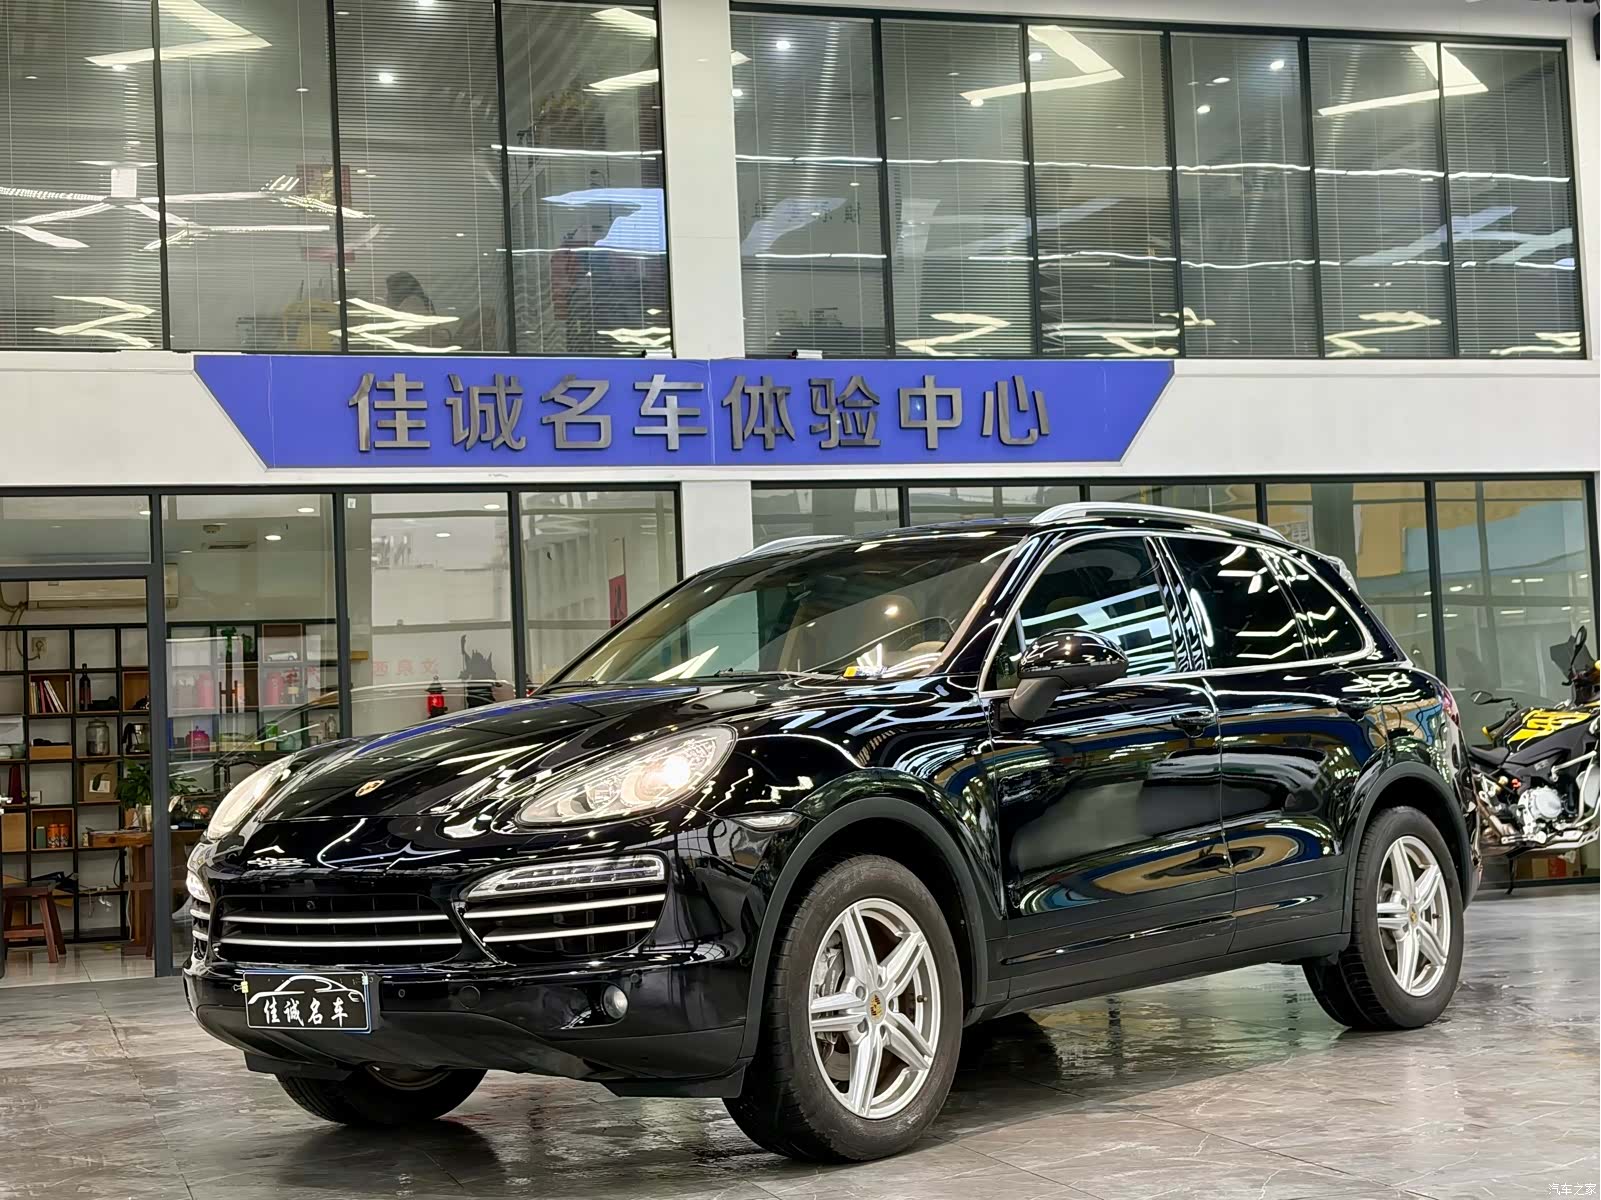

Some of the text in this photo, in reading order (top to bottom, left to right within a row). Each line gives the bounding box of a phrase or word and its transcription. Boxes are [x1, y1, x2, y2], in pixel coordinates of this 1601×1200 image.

[349, 372, 1051, 451] 佳诚名车体验中心
[264, 997, 348, 1027] 佳诚名车
